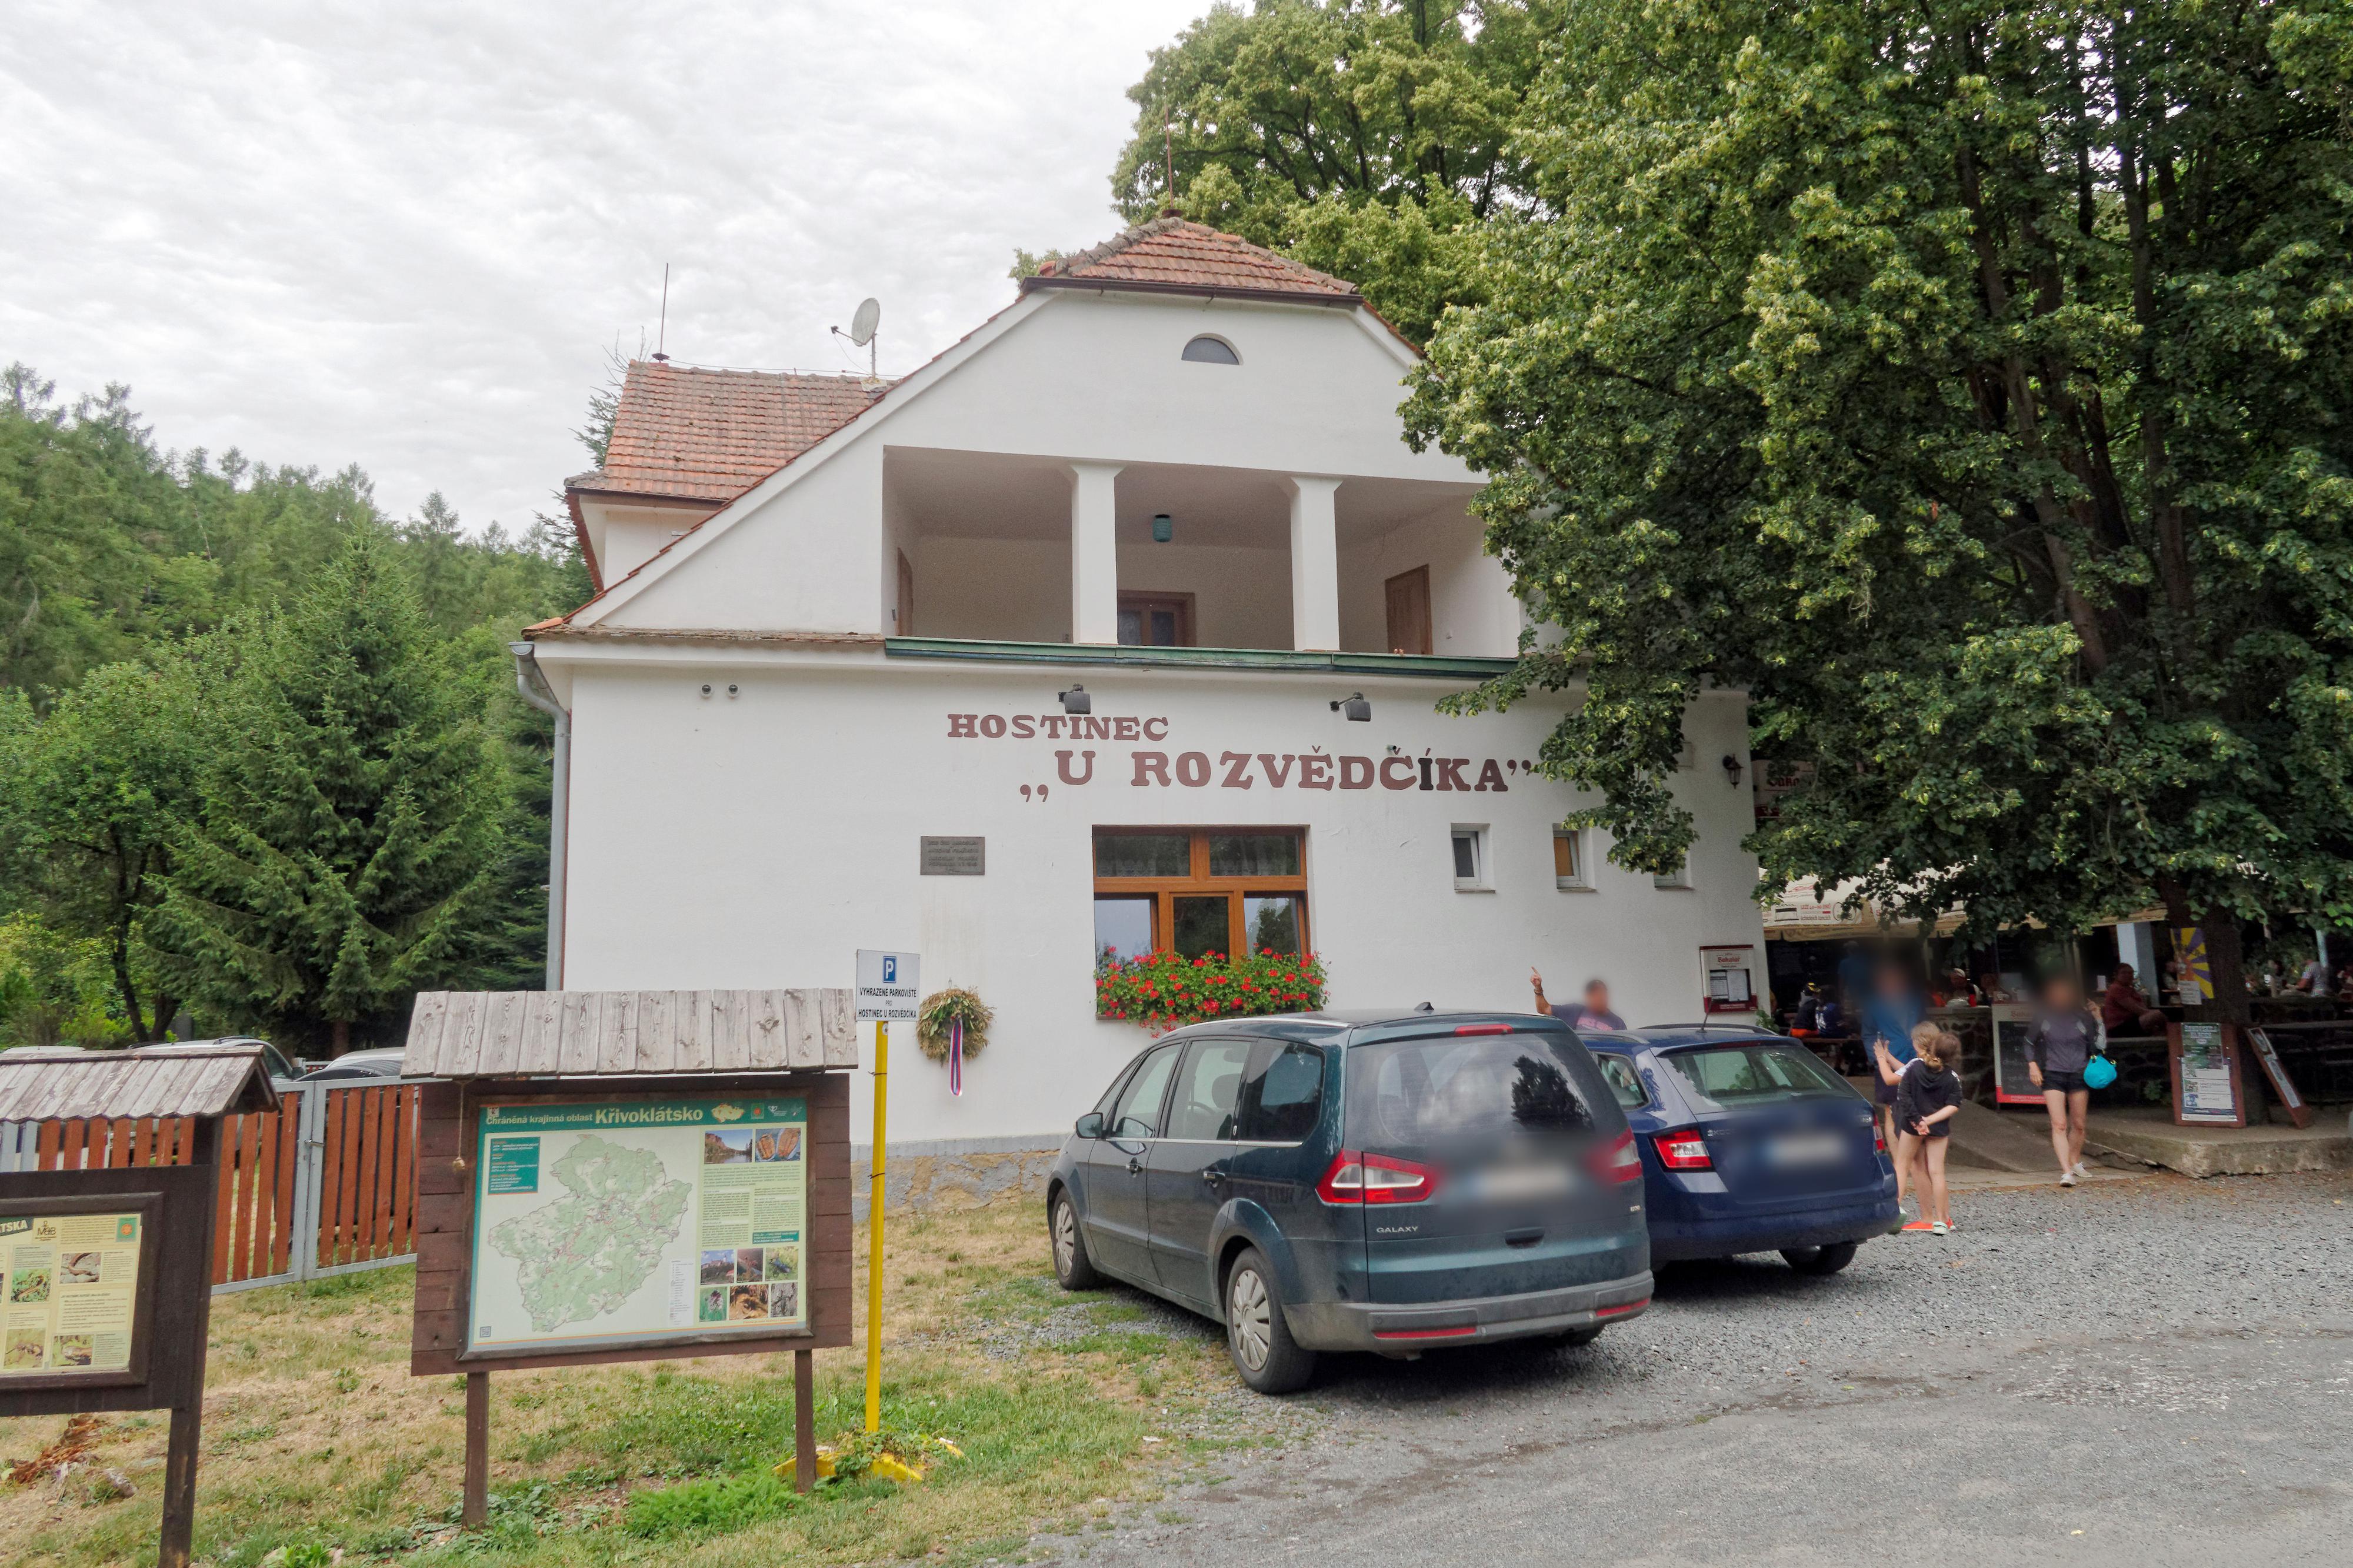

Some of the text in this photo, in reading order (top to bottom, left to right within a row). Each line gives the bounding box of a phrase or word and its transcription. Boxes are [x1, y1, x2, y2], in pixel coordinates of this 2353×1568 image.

[947, 713, 1169, 741] HOSTINEC
[885, 960, 894, 979] P
[858, 1008, 882, 1017] HOSTINEC
[884, 1009, 888, 1017] U
[486, 1106, 704, 1125] Chráněná krajinná oblast Křivoklátsko
